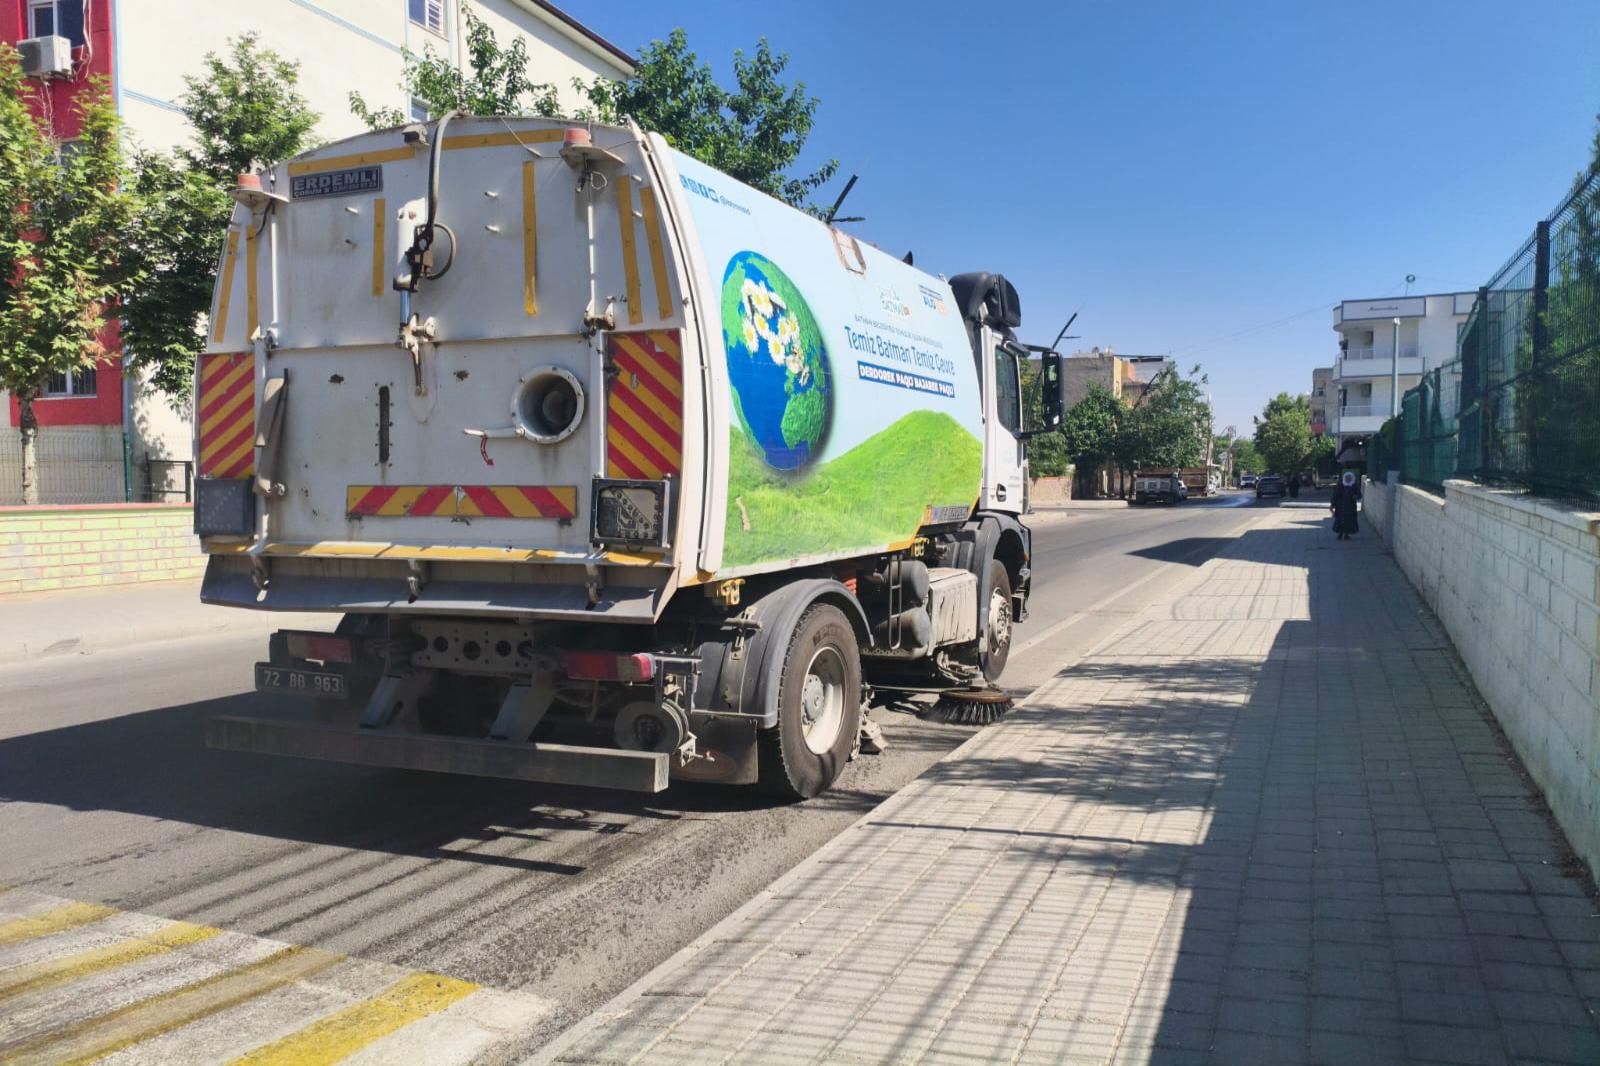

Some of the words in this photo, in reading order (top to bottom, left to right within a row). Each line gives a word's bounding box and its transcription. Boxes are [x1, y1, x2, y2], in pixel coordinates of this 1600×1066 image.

[844, 325, 877, 355] Temiz
[877, 335, 911, 364] Batman
[911, 345, 935, 370] Temiz
[264, 669, 280, 687] 72
[314, 675, 340, 692] 963
